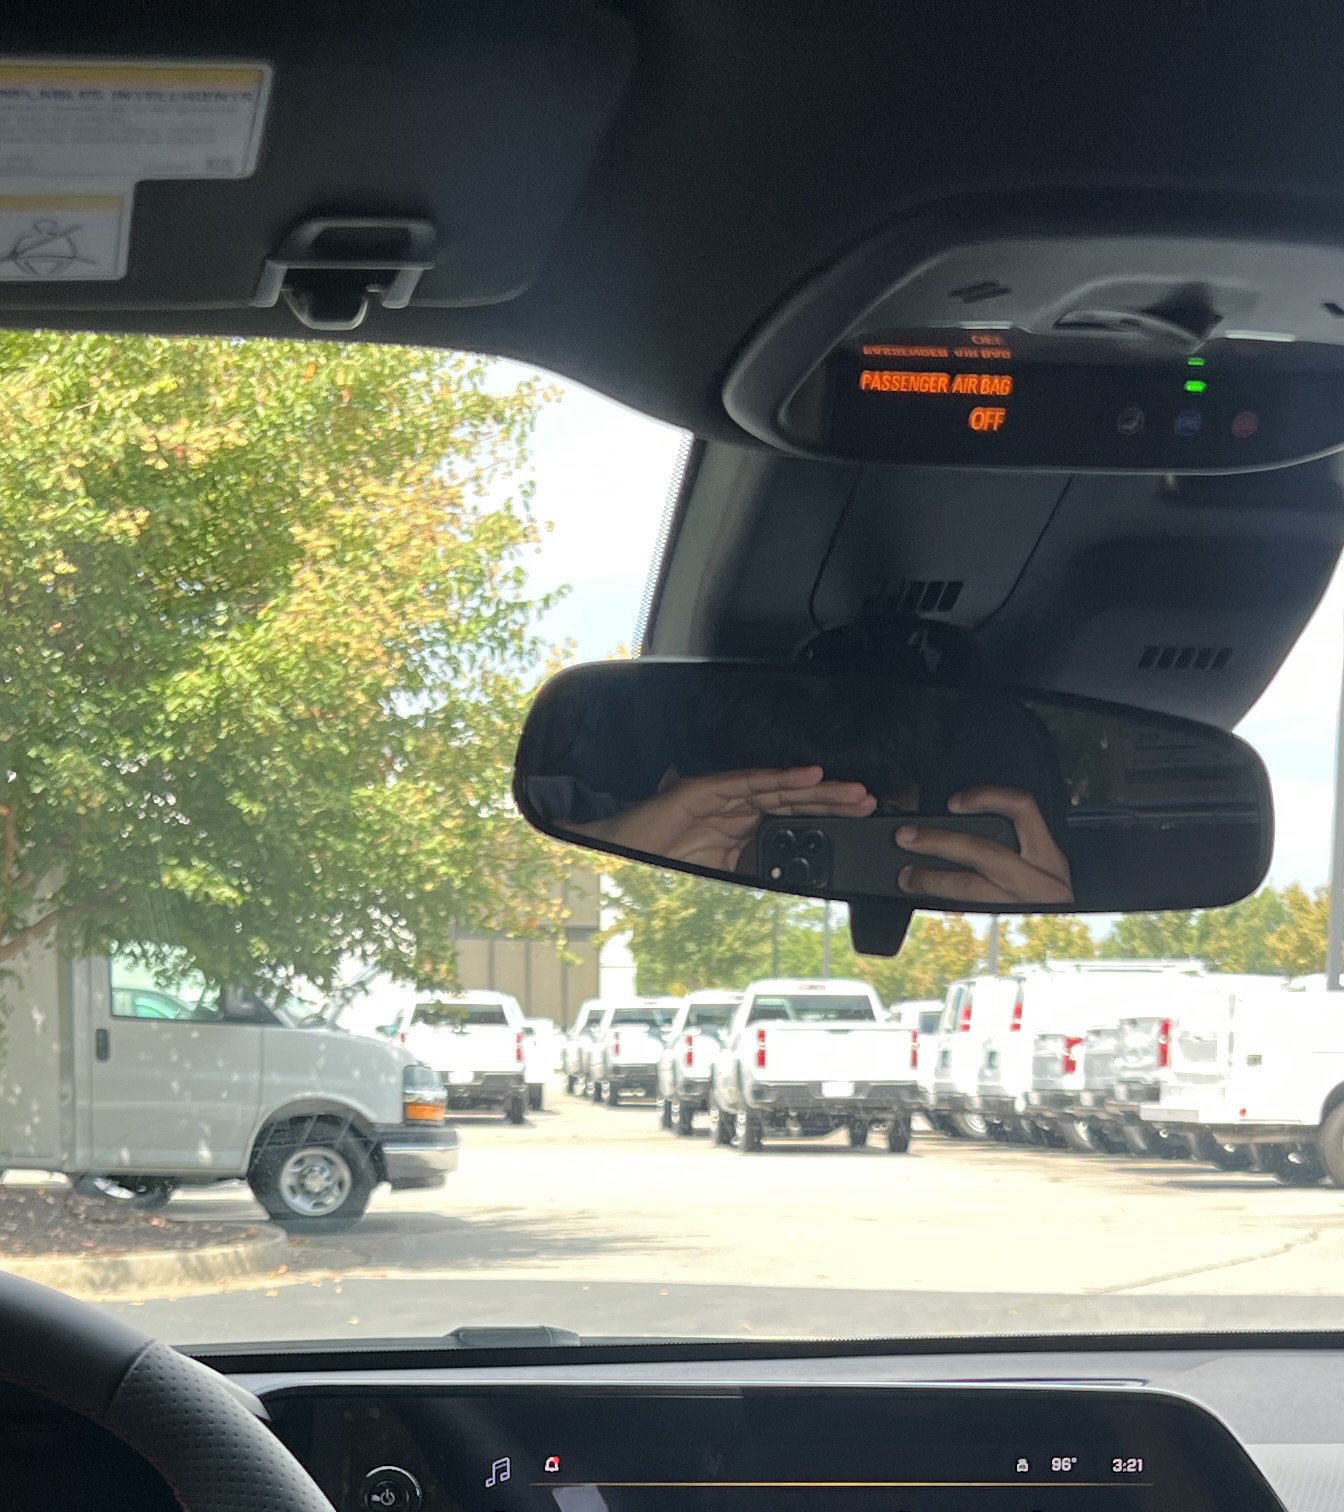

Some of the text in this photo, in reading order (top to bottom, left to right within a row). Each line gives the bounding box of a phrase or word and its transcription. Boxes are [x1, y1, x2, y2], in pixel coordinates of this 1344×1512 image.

[861, 371, 1013, 395] PASSENGER AIR BAG
[970, 407, 1007, 431] OFF
[1112, 1458, 1143, 1472] 3:21
